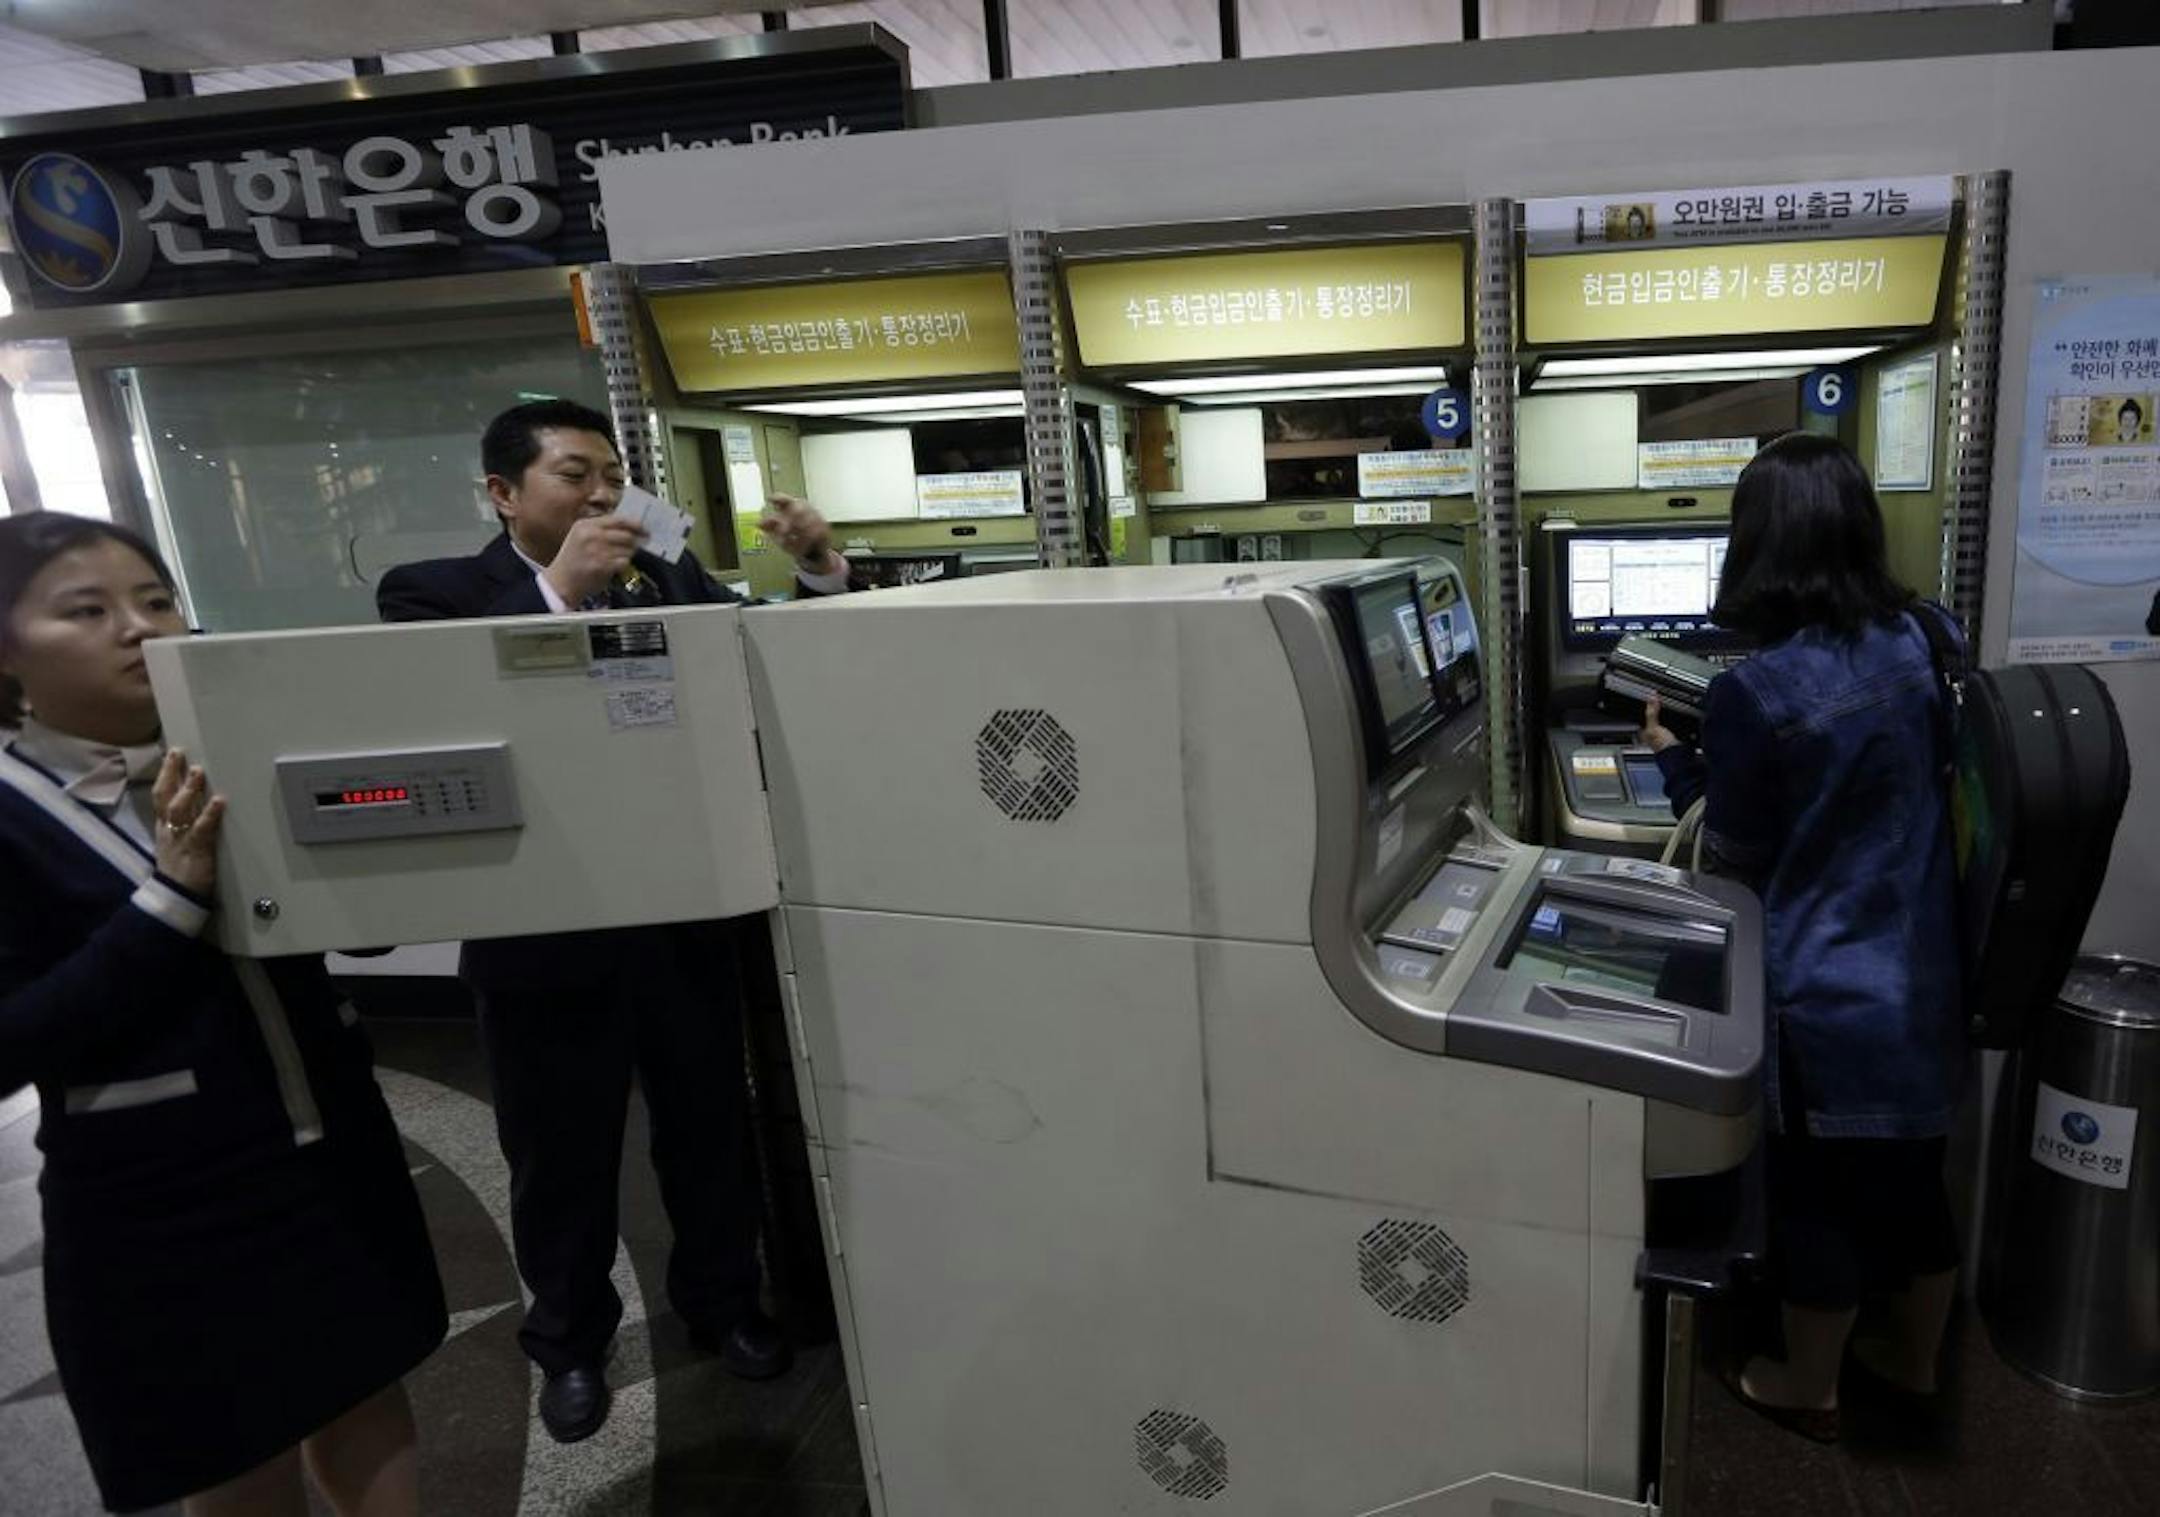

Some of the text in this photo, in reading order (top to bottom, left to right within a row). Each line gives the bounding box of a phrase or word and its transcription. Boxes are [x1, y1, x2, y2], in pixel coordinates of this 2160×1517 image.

[138, 123, 560, 267] 신한은행
[1672, 187, 1910, 226] 오만원권 입·출금 가능
[1817, 372, 1843, 407] 6
[1436, 397, 1460, 430] 5
[2038, 1134, 2123, 1175] 신한은행
